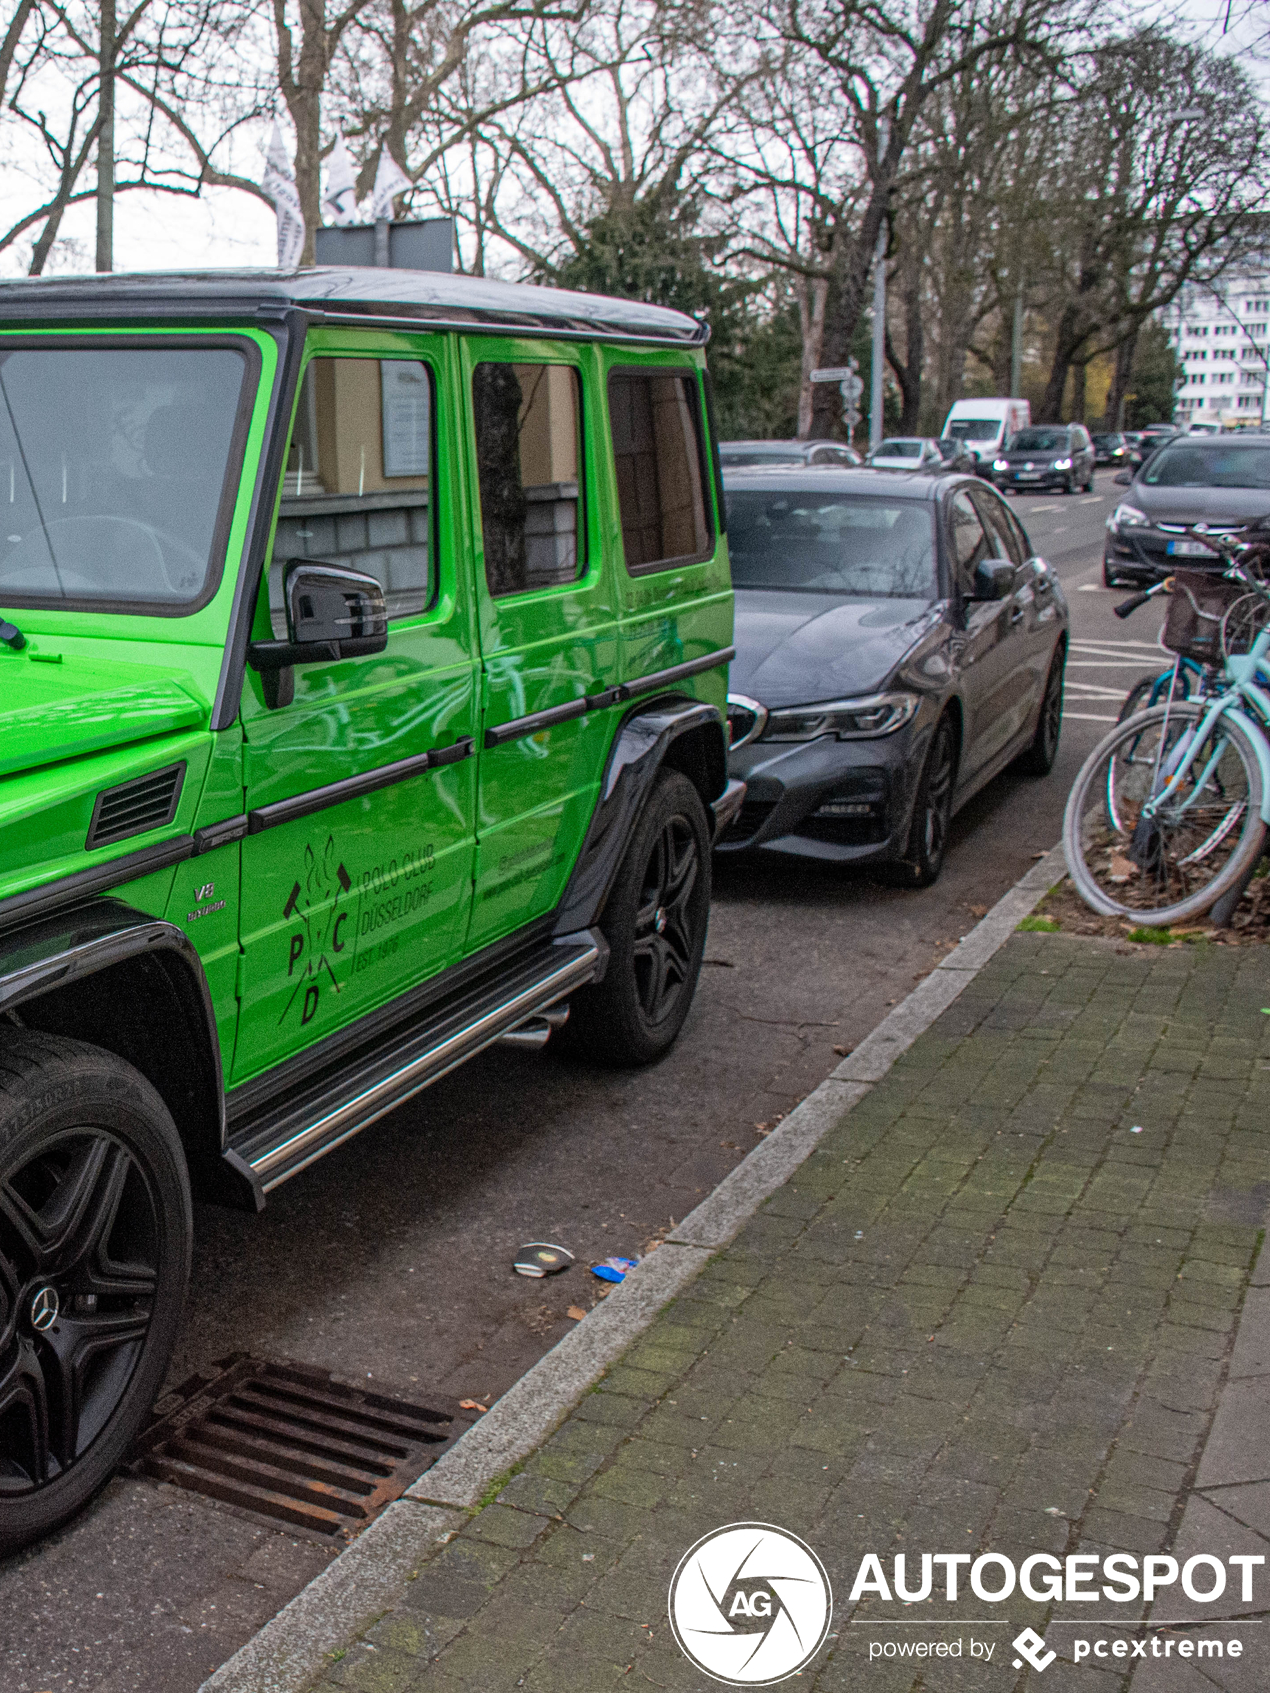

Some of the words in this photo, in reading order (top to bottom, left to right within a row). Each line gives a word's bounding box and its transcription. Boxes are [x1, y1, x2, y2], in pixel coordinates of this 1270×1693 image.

[194, 882, 215, 903] V8
[362, 859, 399, 898] POLO
[403, 843, 435, 880] CLUB
[361, 880, 433, 936] DÜSSELDORF
[288, 933, 304, 977] P
[332, 912, 348, 953] C
[301, 985, 319, 1026] D
